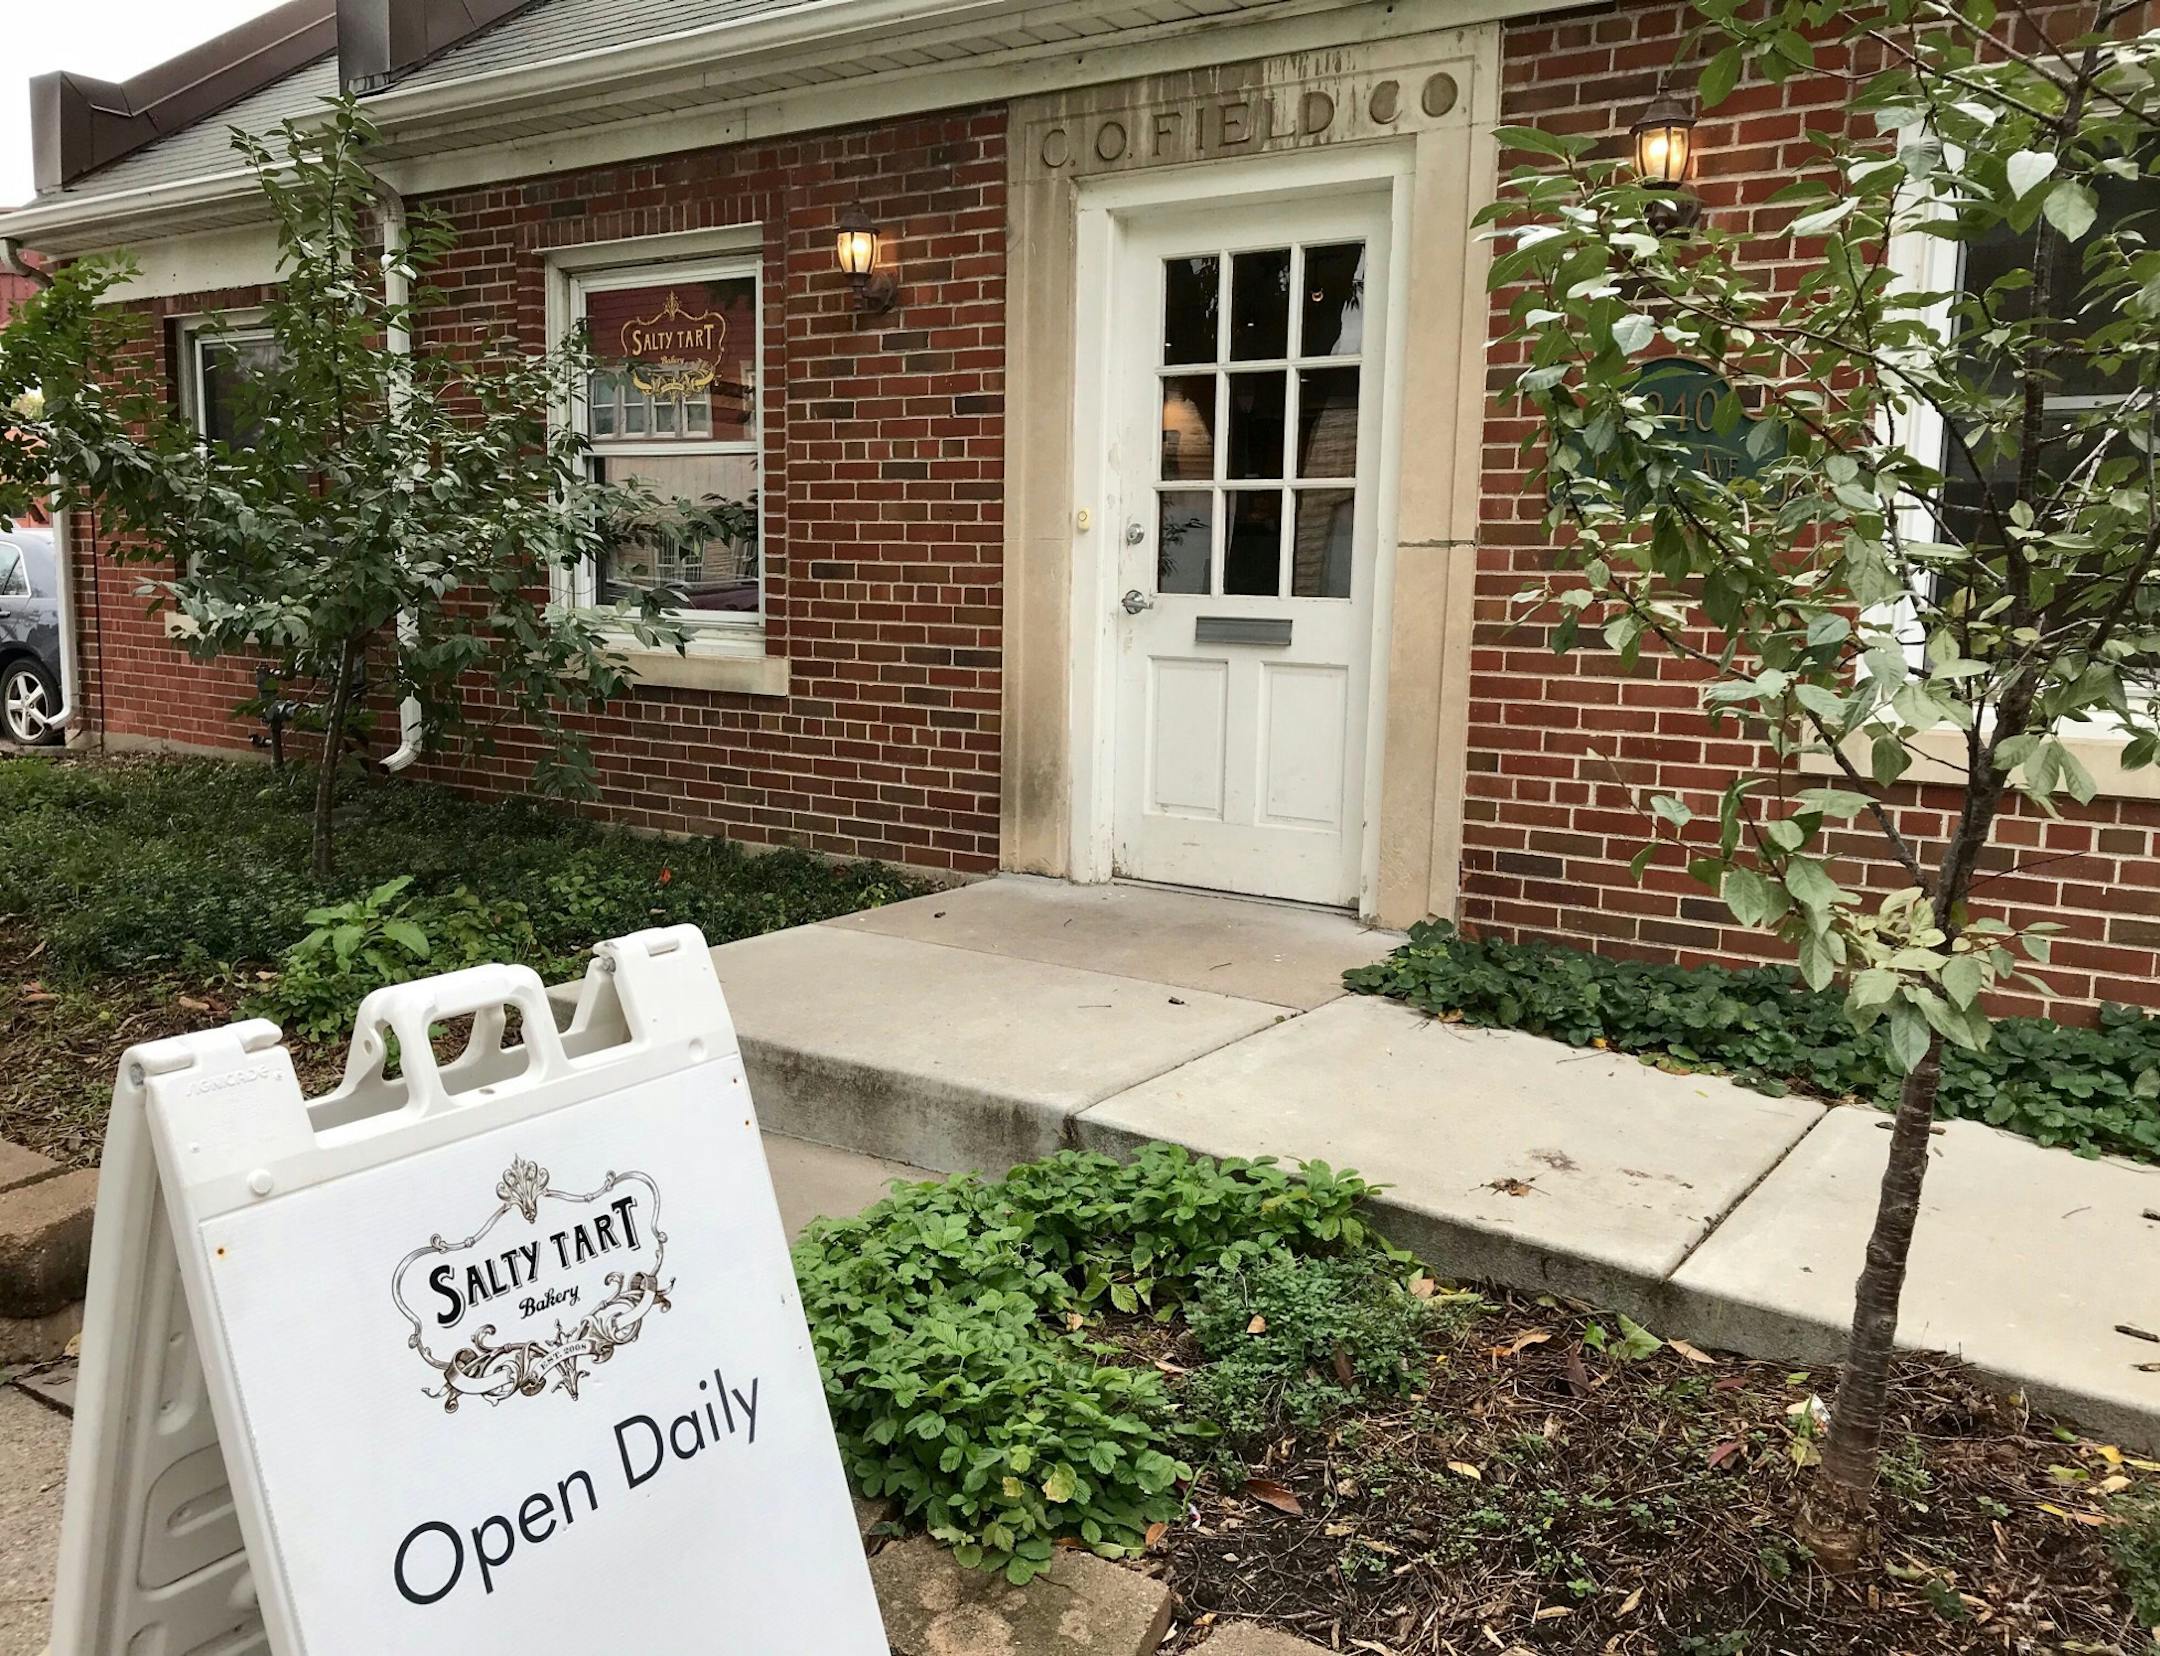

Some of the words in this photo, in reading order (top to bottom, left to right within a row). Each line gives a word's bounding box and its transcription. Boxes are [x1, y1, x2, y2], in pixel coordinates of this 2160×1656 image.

[1152, 91, 1335, 156] FIELD
[631, 329, 674, 356] SALTY
[676, 324, 714, 351] TART
[429, 1240, 542, 1329] SALTY
[549, 1195, 642, 1270] TART
[518, 1284, 581, 1320] Bakery
[393, 1469, 599, 1605] Open
[613, 1368, 759, 1490] Daily
